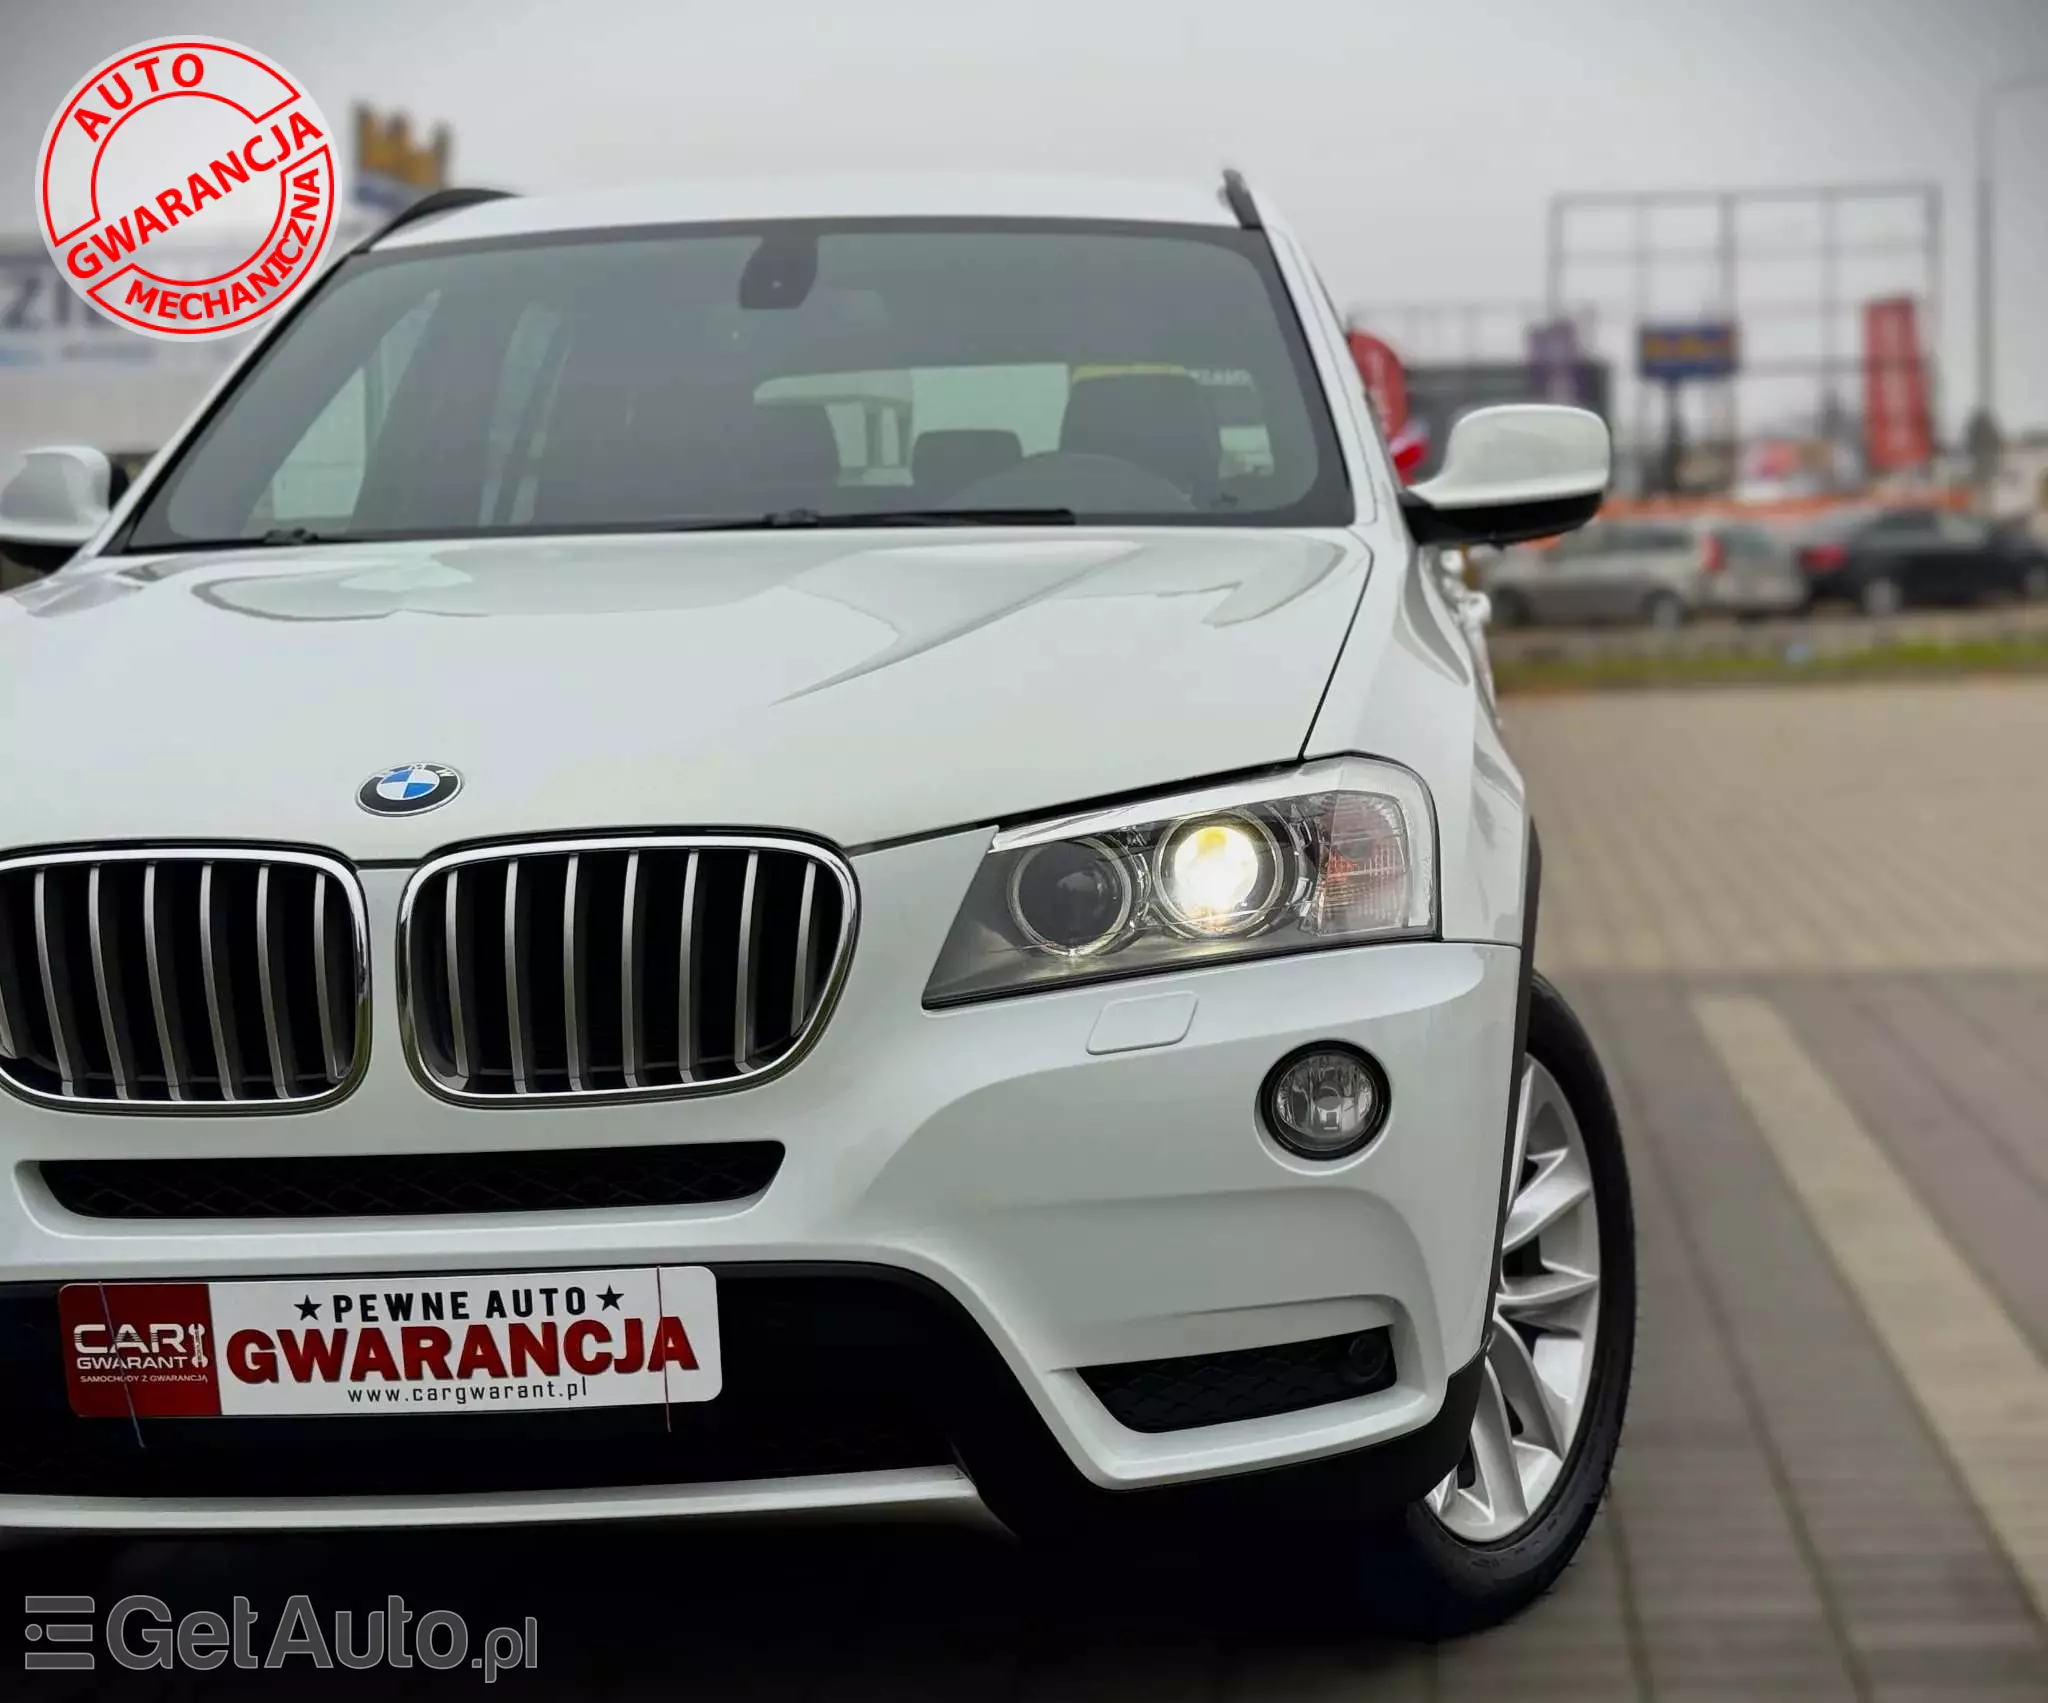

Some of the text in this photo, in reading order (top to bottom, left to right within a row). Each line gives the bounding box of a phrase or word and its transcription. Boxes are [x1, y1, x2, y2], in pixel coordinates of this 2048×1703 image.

[333, 1286, 586, 1323] PEWNE AUTO
[73, 1323, 188, 1354] CAR
[226, 1316, 700, 1384] GWARANCJA
[76, 1356, 188, 1370] GWARANT
[347, 1376, 588, 1405] www.cargwarant.pl
